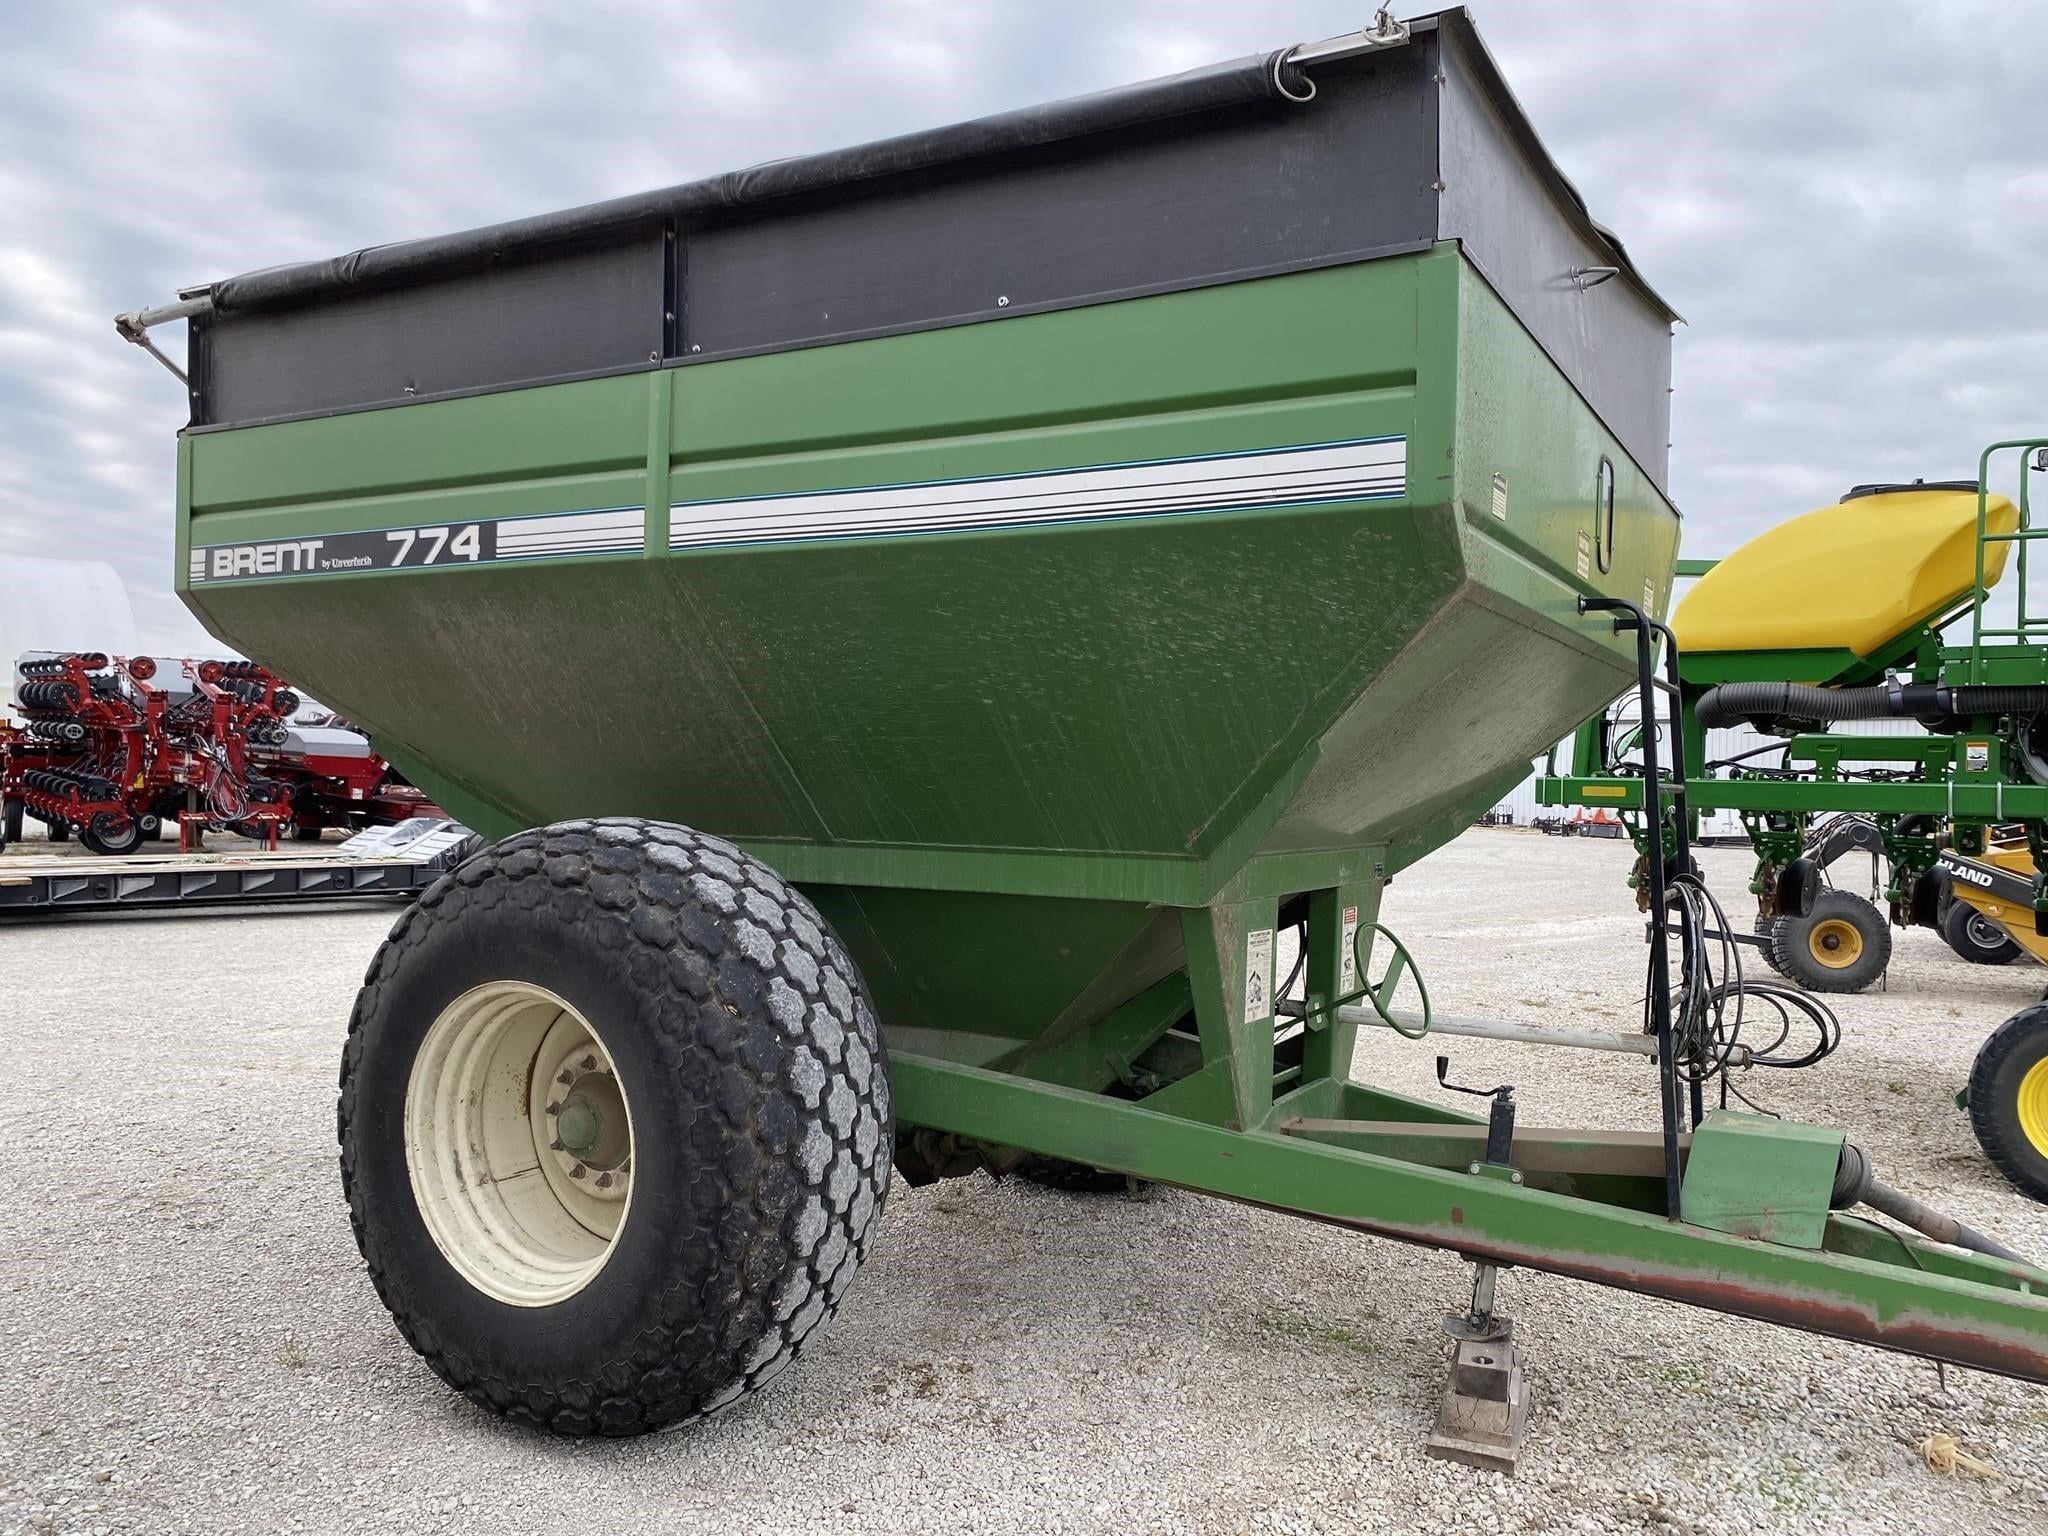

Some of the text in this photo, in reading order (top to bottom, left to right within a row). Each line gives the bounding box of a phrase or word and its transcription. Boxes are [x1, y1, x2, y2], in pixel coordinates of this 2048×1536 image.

[213, 524, 481, 578] BRENT by Unverferth 774
